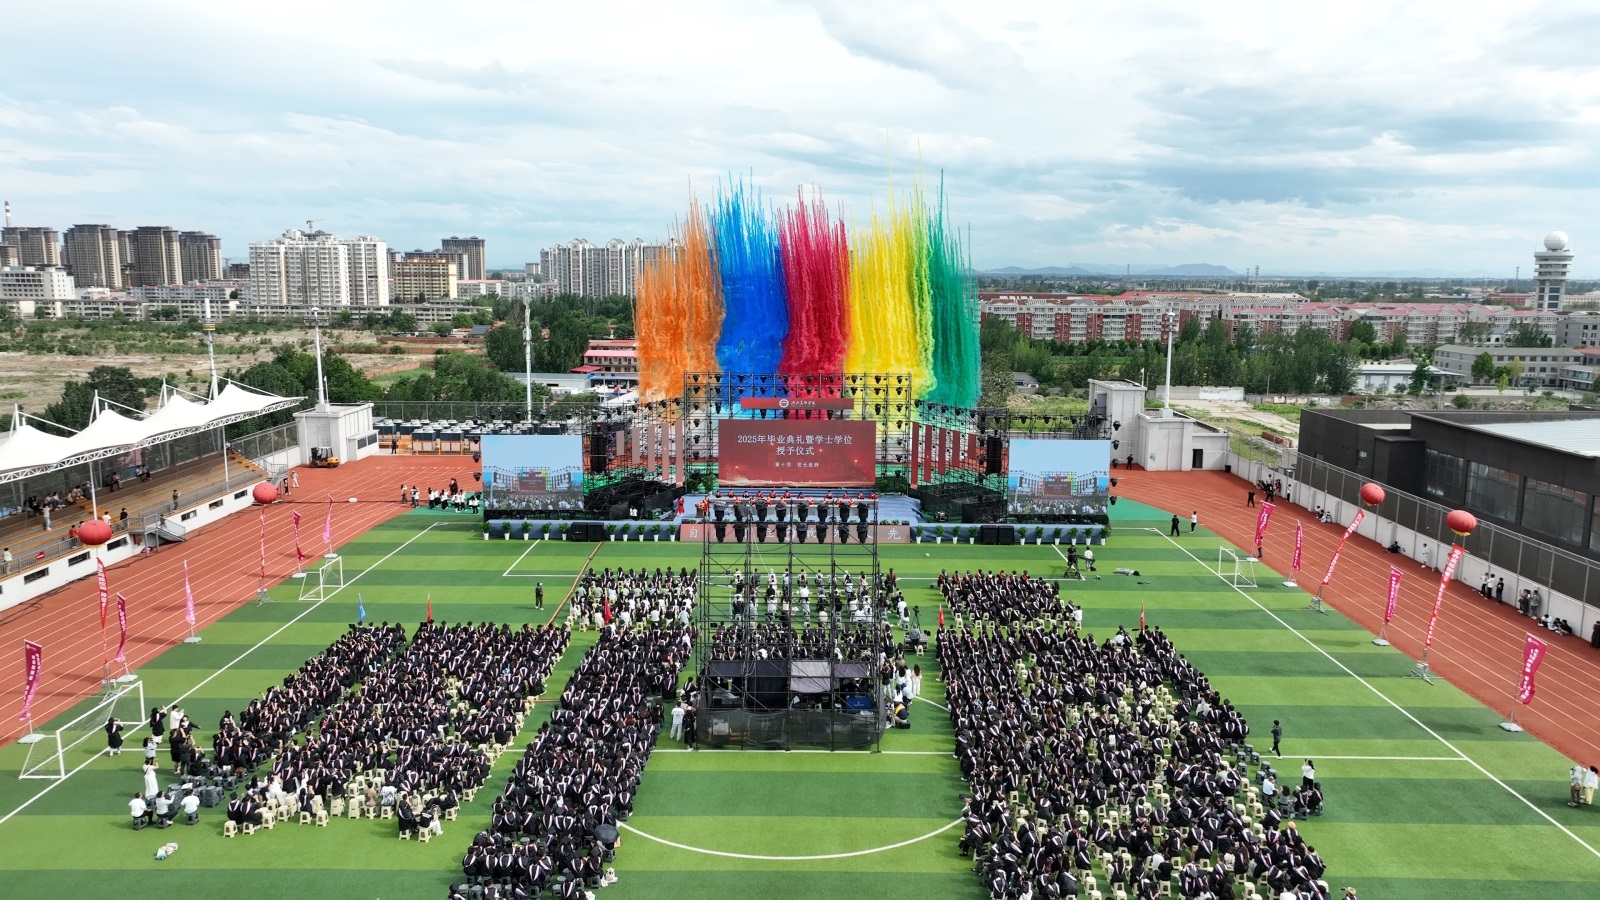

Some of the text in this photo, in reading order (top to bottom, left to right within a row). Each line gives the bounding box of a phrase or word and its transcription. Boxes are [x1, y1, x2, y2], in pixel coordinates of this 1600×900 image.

[737, 434, 853, 445] 2025年毕业典礼暨学士学位
[776, 446, 815, 456] 授予仪式
